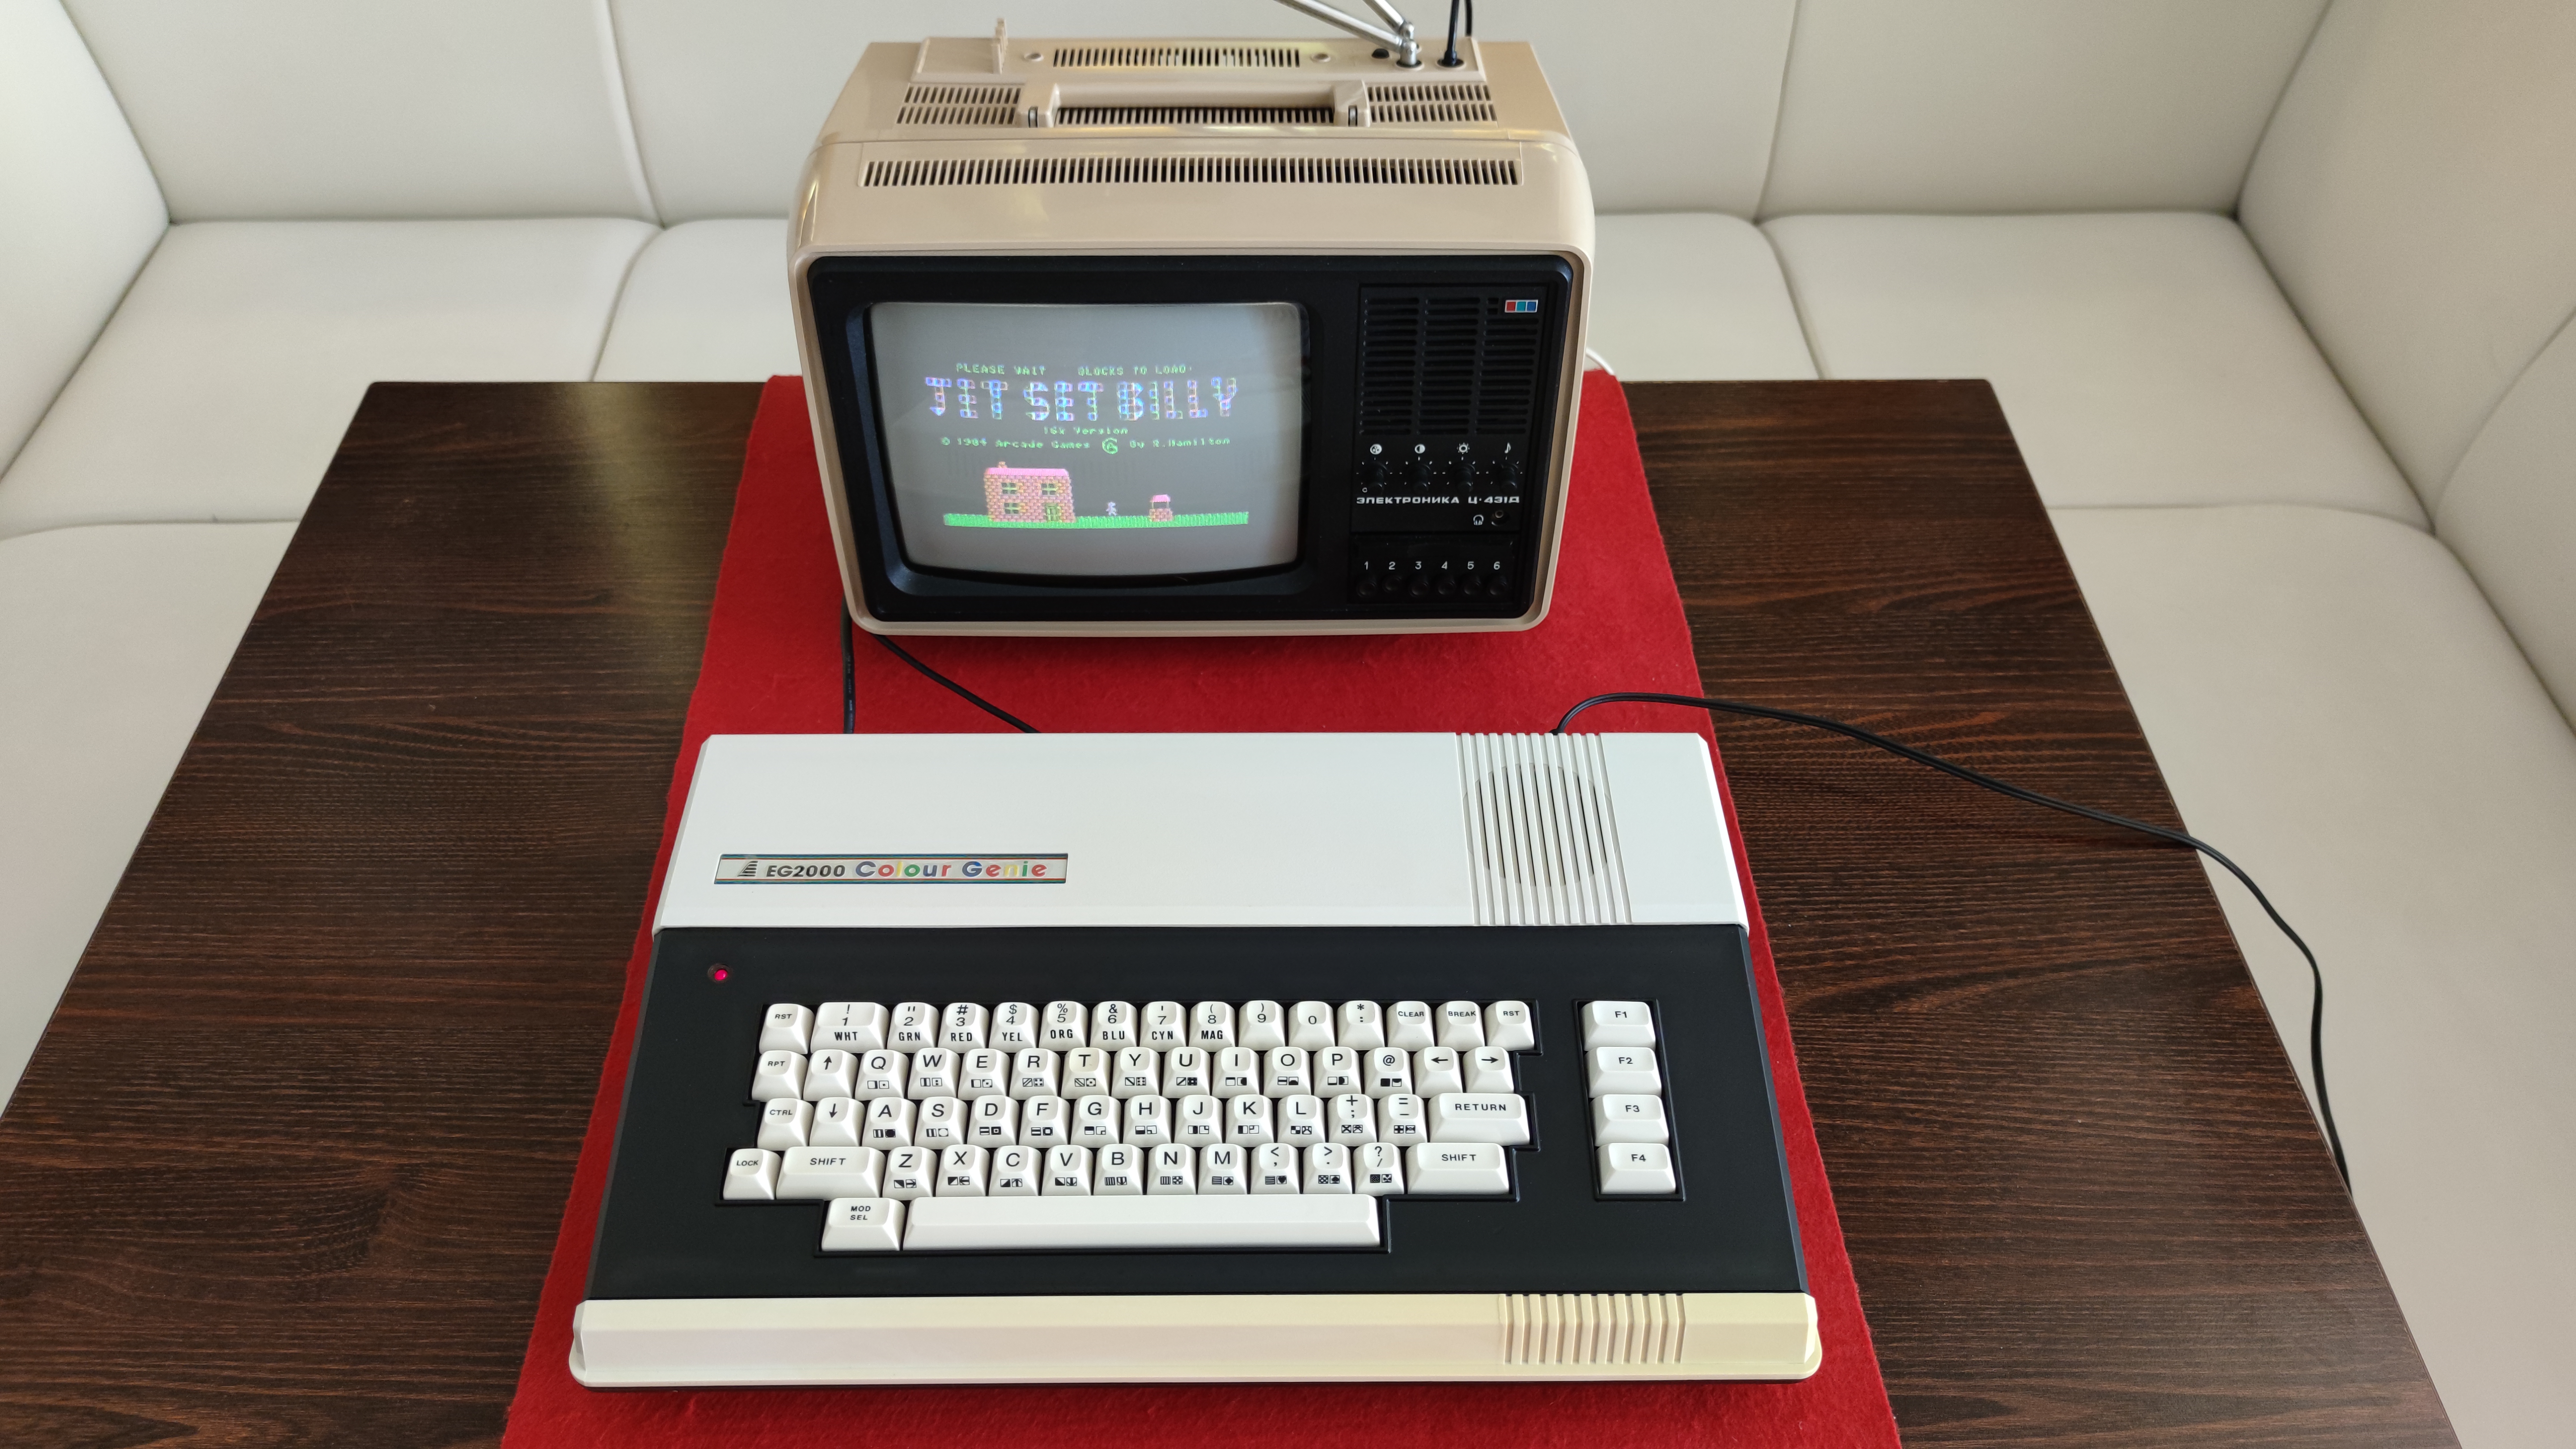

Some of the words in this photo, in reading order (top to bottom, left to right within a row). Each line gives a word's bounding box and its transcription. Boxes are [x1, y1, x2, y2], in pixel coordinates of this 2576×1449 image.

[956, 363, 1005, 374] PLEASE
[1014, 365, 1046, 375] WAIT
[1133, 365, 1147, 375] TO
[925, 377, 1008, 419] JET
[1023, 381, 1104, 421] SET
[1117, 377, 1237, 421] BILLY
[996, 440, 1043, 448] Arcade
[1051, 441, 1090, 449] Games
[1364, 562, 1368, 570] 1
[1389, 562, 1395, 570] 2
[1415, 561, 1422, 570] 3
[1441, 561, 1448, 570] 4
[1467, 561, 1474, 570] 5
[1493, 561, 1500, 570] 6
[766, 865, 846, 877] EG2000
[855, 861, 951, 877] Colour
[962, 861, 1047, 877] Genie
[843, 1017, 848, 1025] 1
[904, 1017, 914, 1025] 2
[956, 1017, 965, 1026] 3
[1006, 1016, 1015, 1025] 4
[1057, 1014, 1066, 1022] 5
[1108, 1015, 1117, 1024] 6
[1158, 1016, 1166, 1025] 7
[1208, 1015, 1216, 1024] 8
[1258, 1014, 1266, 1022] 9
[1308, 1016, 1317, 1024] 0
[835, 1032, 858, 1041] WHT
[899, 1032, 921, 1041] GRN
[951, 1032, 973, 1042] RED
[1002, 1032, 1022, 1041] YEL
[1051, 1029, 1073, 1039] ORG
[1103, 1031, 1125, 1040] BLU
[1152, 1031, 1173, 1040] CYN
[1201, 1030, 1223, 1040] MAG
[871, 1056, 886, 1070] Q
[923, 1054, 942, 1068] W
[977, 1055, 988, 1068] E
[1028, 1055, 1040, 1068] R
[1078, 1054, 1091, 1067] T
[1129, 1054, 1141, 1066] Y
[1179, 1054, 1193, 1067] U
[1281, 1054, 1295, 1067] O
[1332, 1054, 1343, 1066] P
[878, 1104, 892, 1117] A
[932, 1104, 944, 1117] S
[985, 1103, 998, 1116] D
[1037, 1103, 1049, 1115] F
[1088, 1102, 1102, 1115] G
[1139, 1102, 1152, 1115] H
[1193, 1102, 1203, 1115] J
[1243, 1102, 1256, 1114] K
[1296, 1102, 1306, 1114] L
[898, 1153, 913, 1167] Z
[954, 1151, 967, 1165] X
[1006, 1152, 1021, 1167] C
[1060, 1152, 1073, 1166] V
[1111, 1152, 1125, 1165] B
[1164, 1151, 1177, 1165] N
[1215, 1151, 1230, 1164] M
